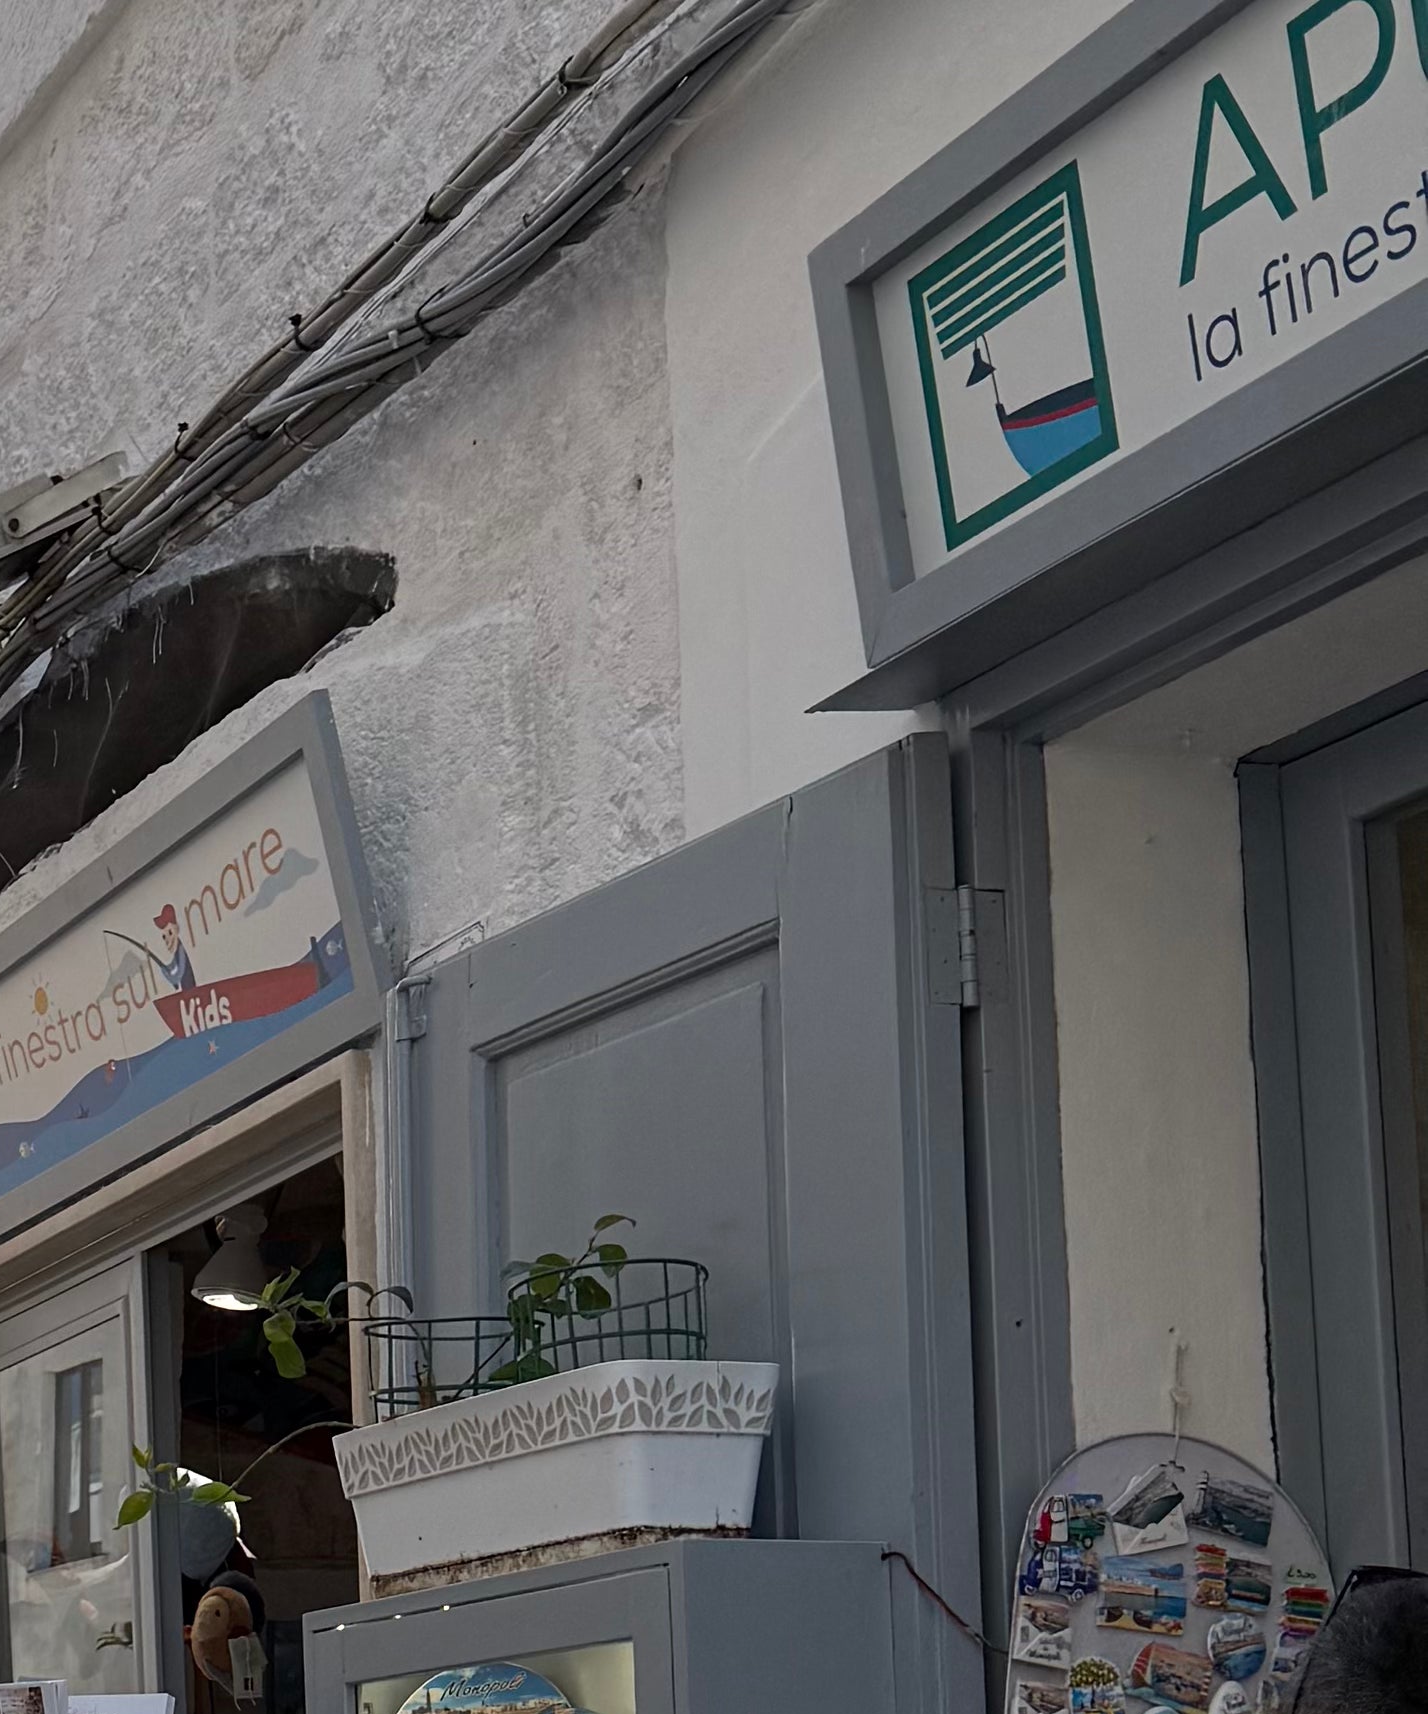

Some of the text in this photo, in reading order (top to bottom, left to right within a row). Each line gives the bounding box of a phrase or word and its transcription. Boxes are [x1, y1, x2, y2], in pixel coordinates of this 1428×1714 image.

[1179, 0, 1428, 287] AP
[1187, 307, 1243, 382] la
[112, 953, 160, 1024] sul
[183, 827, 285, 948] mare
[179, 989, 234, 1038] Kids
[440, 1670, 529, 1702] Monopoli
